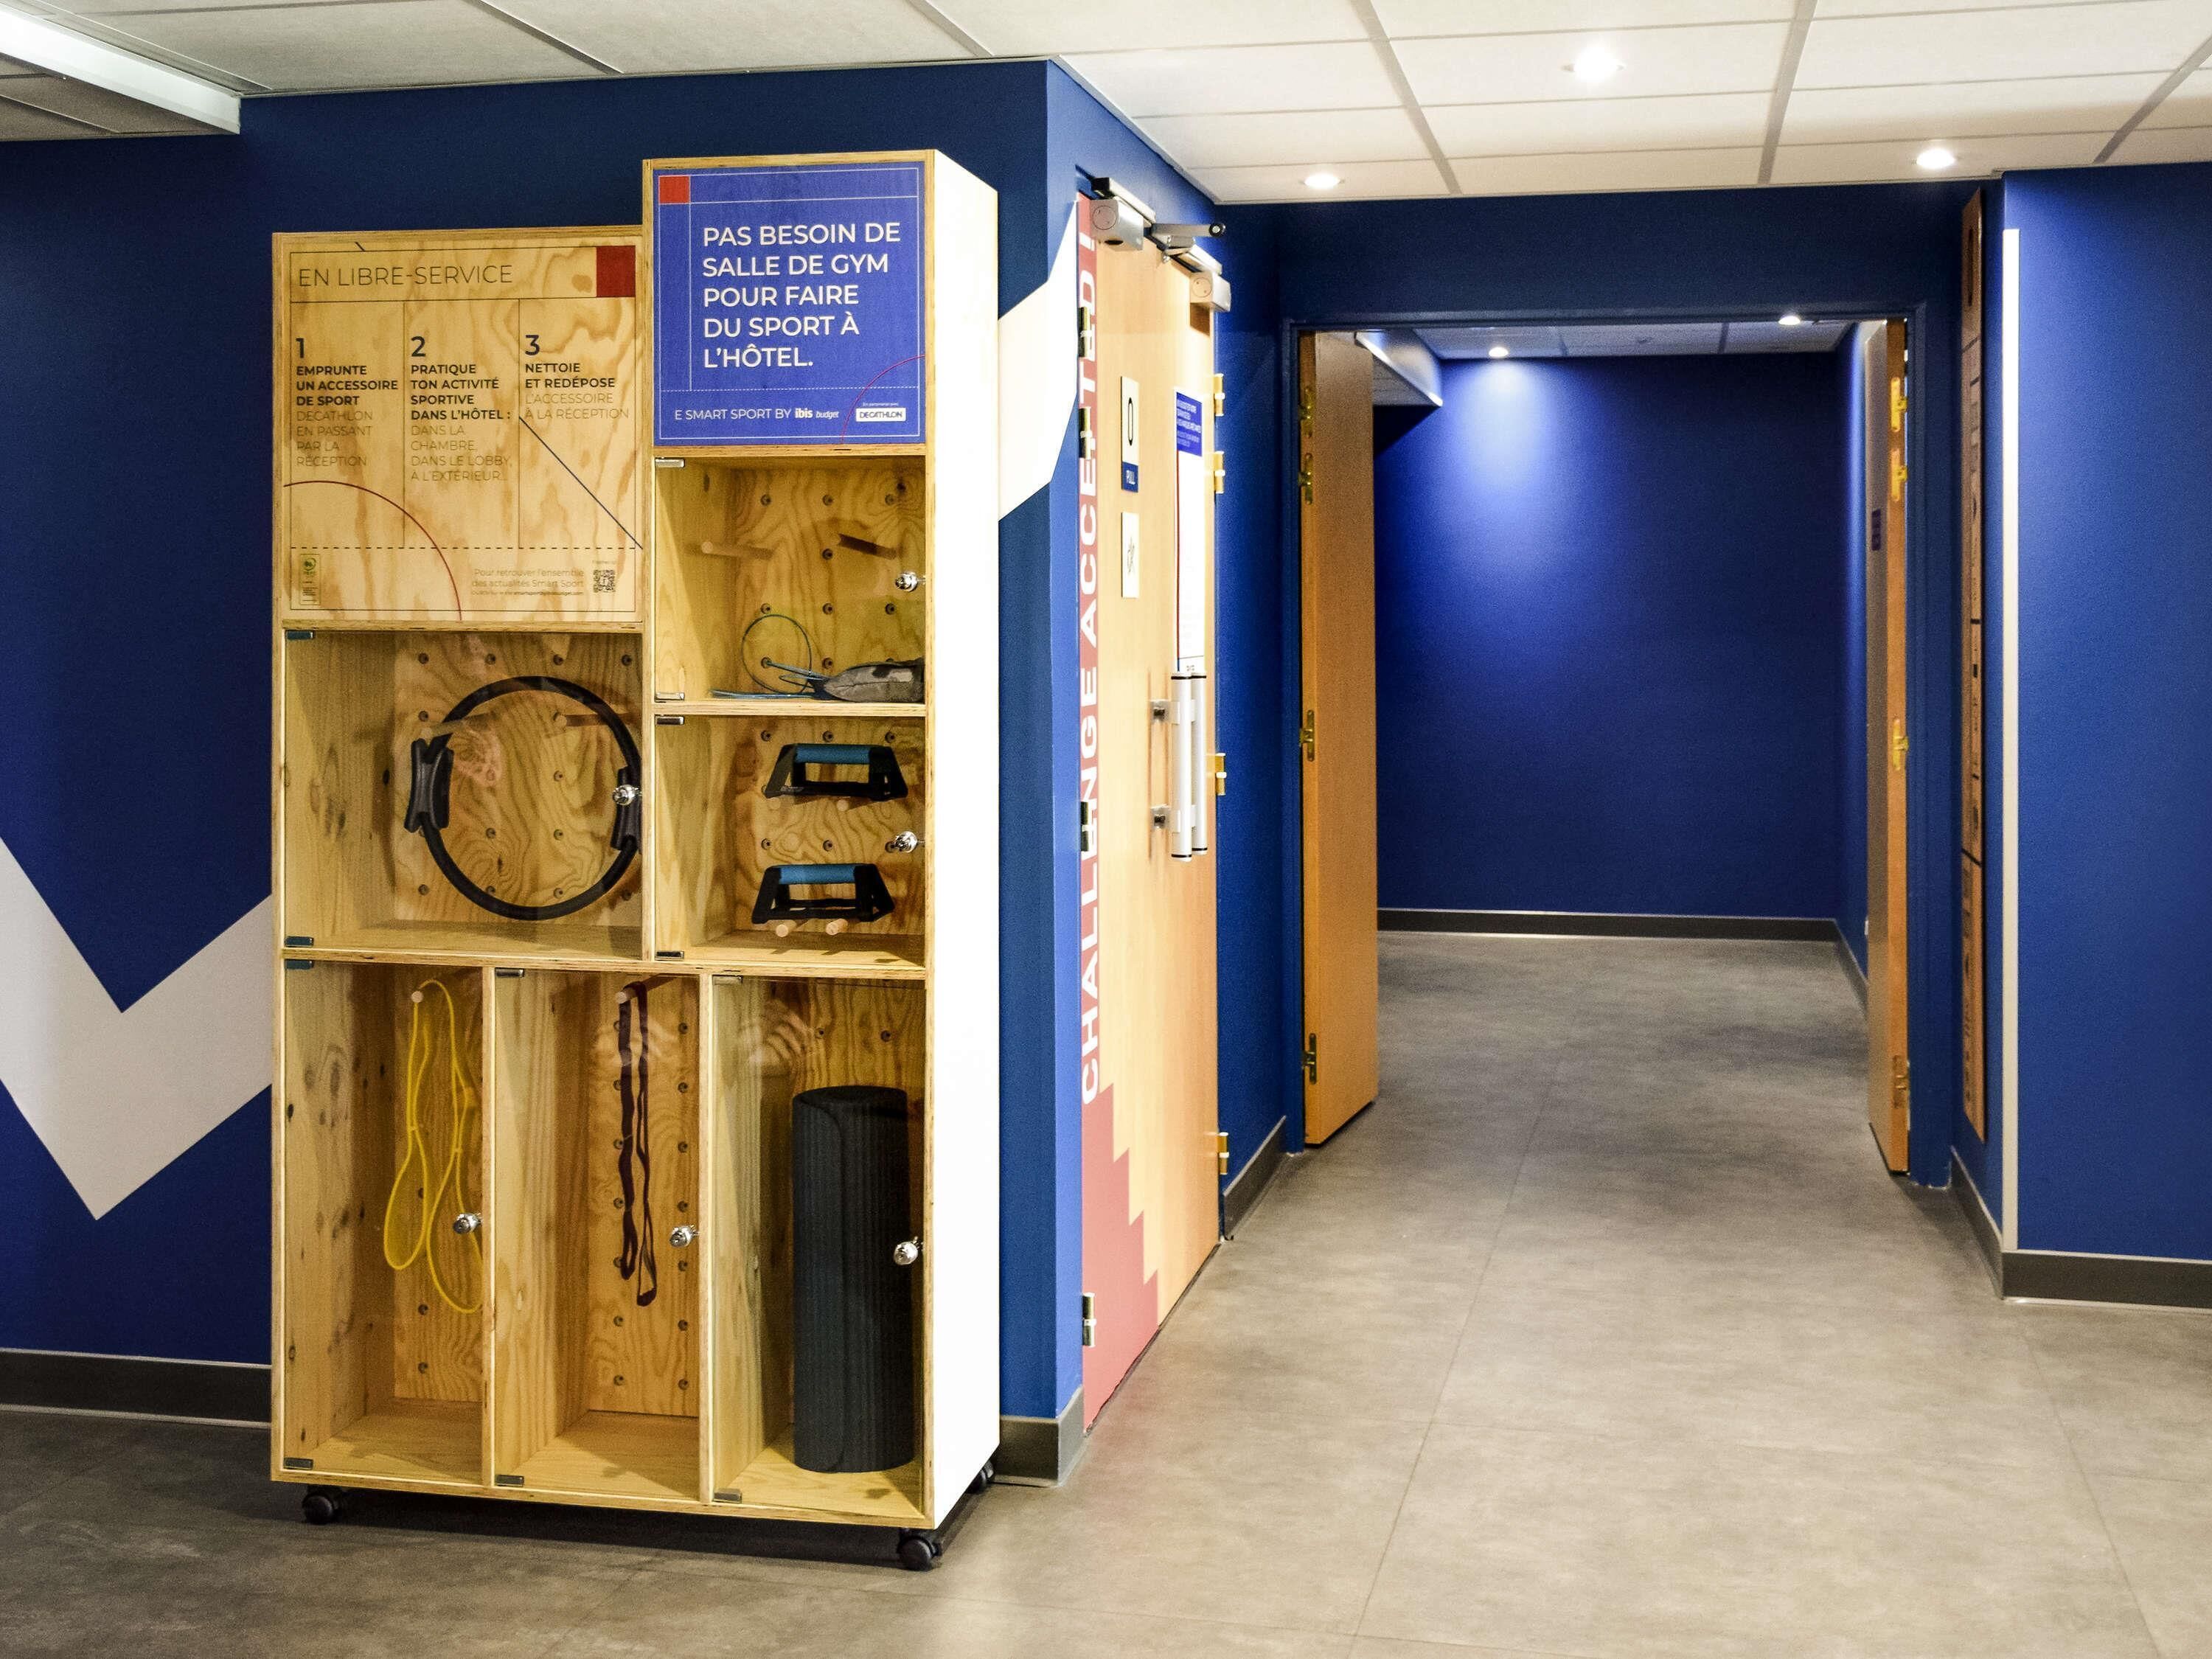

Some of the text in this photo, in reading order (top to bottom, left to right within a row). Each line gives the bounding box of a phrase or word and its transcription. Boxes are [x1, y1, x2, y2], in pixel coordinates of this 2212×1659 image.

[703, 222, 901, 247] PAS BESOIN DE
[703, 253, 888, 277] SALLE DE GYM
[299, 265, 513, 287] EN LIBRE-SERVICE
[703, 285, 859, 307] POUR FAIRE
[703, 311, 860, 338] DU SPORT À
[296, 338, 305, 358] 1
[411, 335, 426, 358] 2
[524, 334, 540, 356] 3
[703, 344, 813, 368] L'HÔTEL.
[296, 365, 367, 376] EMPRUNTE
[411, 364, 476, 376] PRATIQUE
[525, 363, 581, 373] NETTOIE
[296, 380, 398, 391] UN ACCESSOIRE
[411, 377, 499, 390] TON ACTIVITÉ
[525, 375, 616, 389] ET REDÉPOSE
[296, 396, 360, 406] DE SPORT
[411, 394, 475, 405] SPORTIVE
[296, 411, 373, 422] DECATHLON
[411, 410, 448, 420] DANS
[537, 408, 553, 420] LA
[685, 409, 728, 420] SMART
[730, 408, 772, 420] SPORT
[775, 408, 791, 419] BY
[795, 408, 813, 419] ibis
[296, 425, 372, 437] EN PASSANT
[411, 425, 465, 436] DANS LA
[296, 441, 340, 451] PAR LA
[411, 455, 447, 466] DANS
[450, 455, 465, 466] LE
